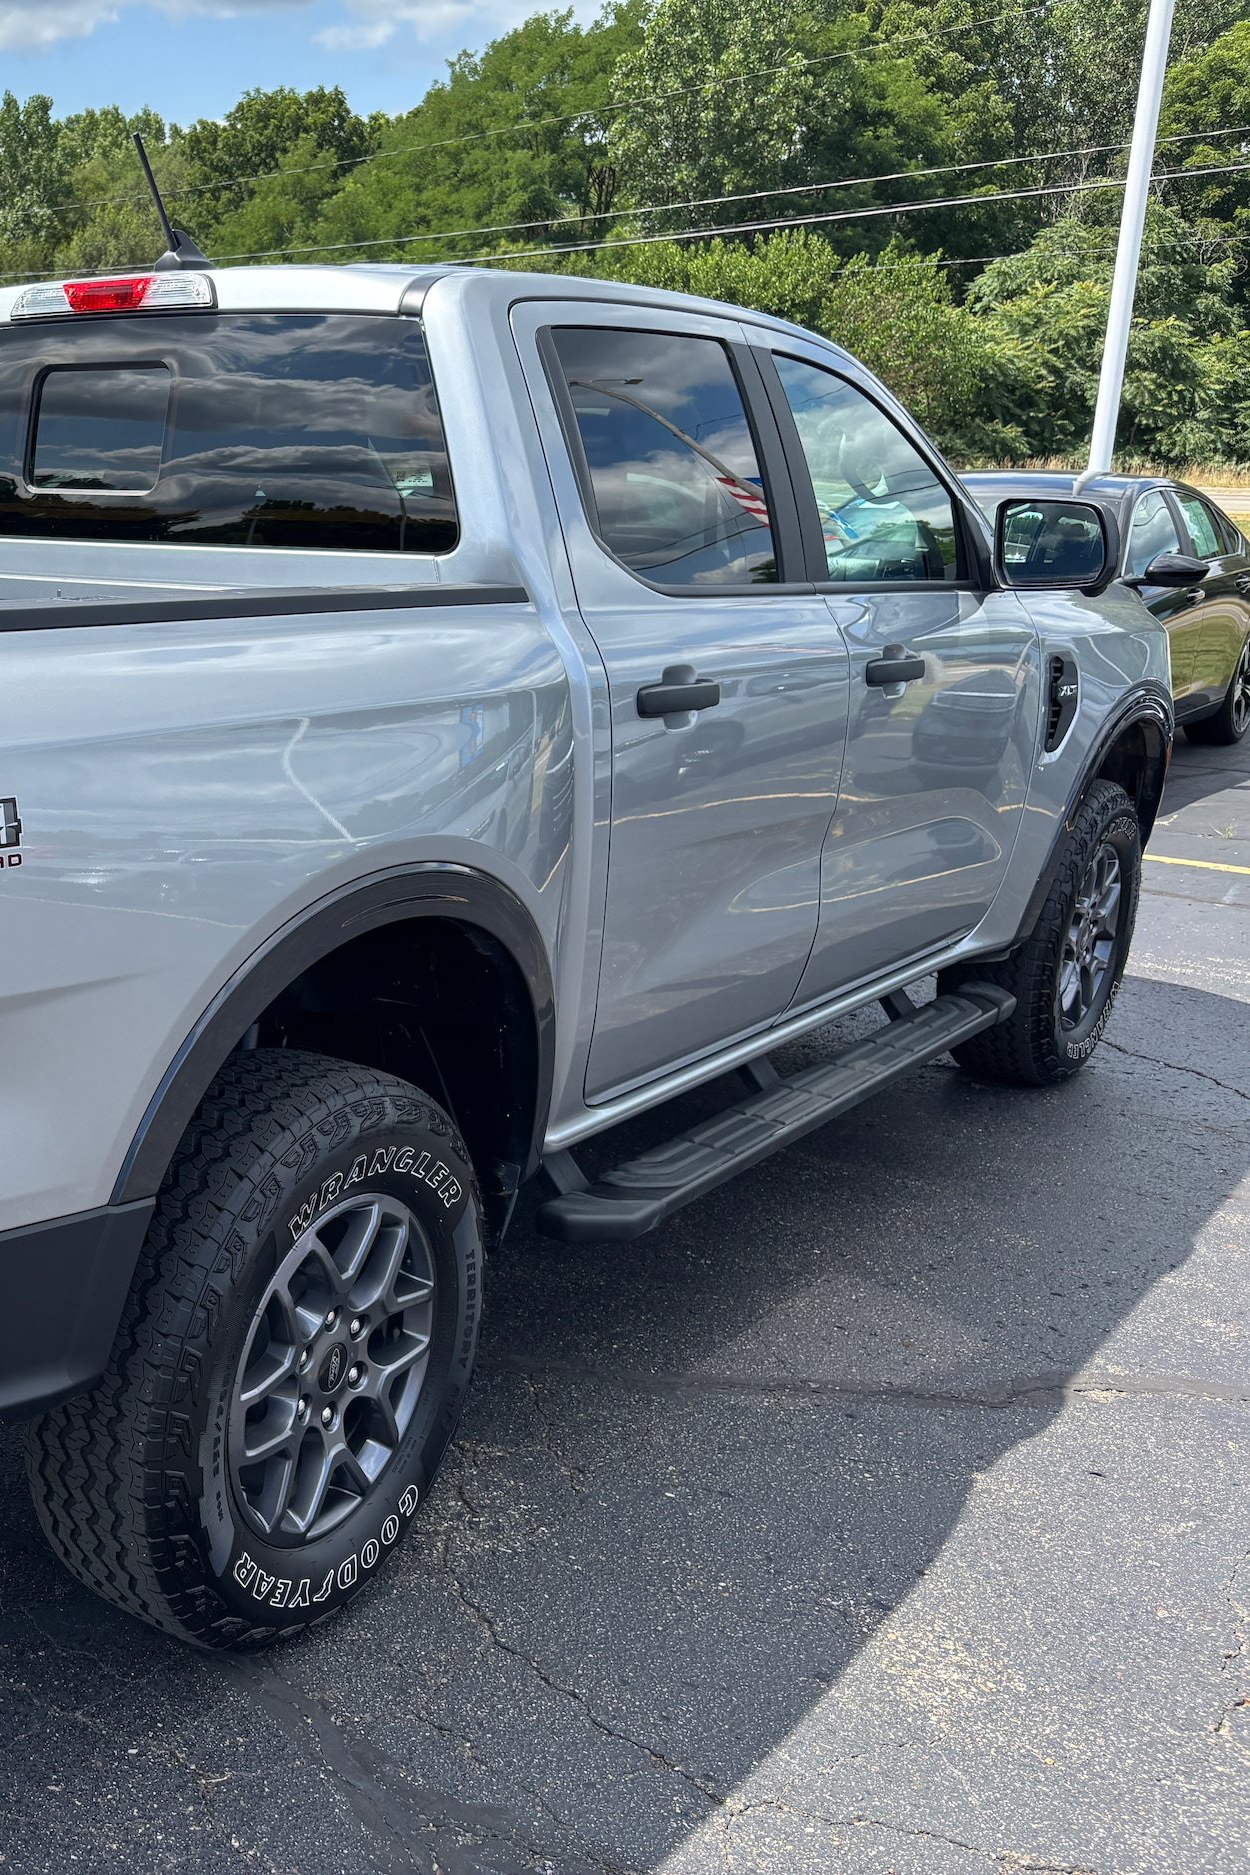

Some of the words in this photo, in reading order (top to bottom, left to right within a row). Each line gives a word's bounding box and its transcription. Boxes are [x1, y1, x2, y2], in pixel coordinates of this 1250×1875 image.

[288, 1145, 463, 1241] WRANGLER
[458, 1248, 477, 1369] TERRITORY
[233, 1485, 419, 1608] GOODYEAR
